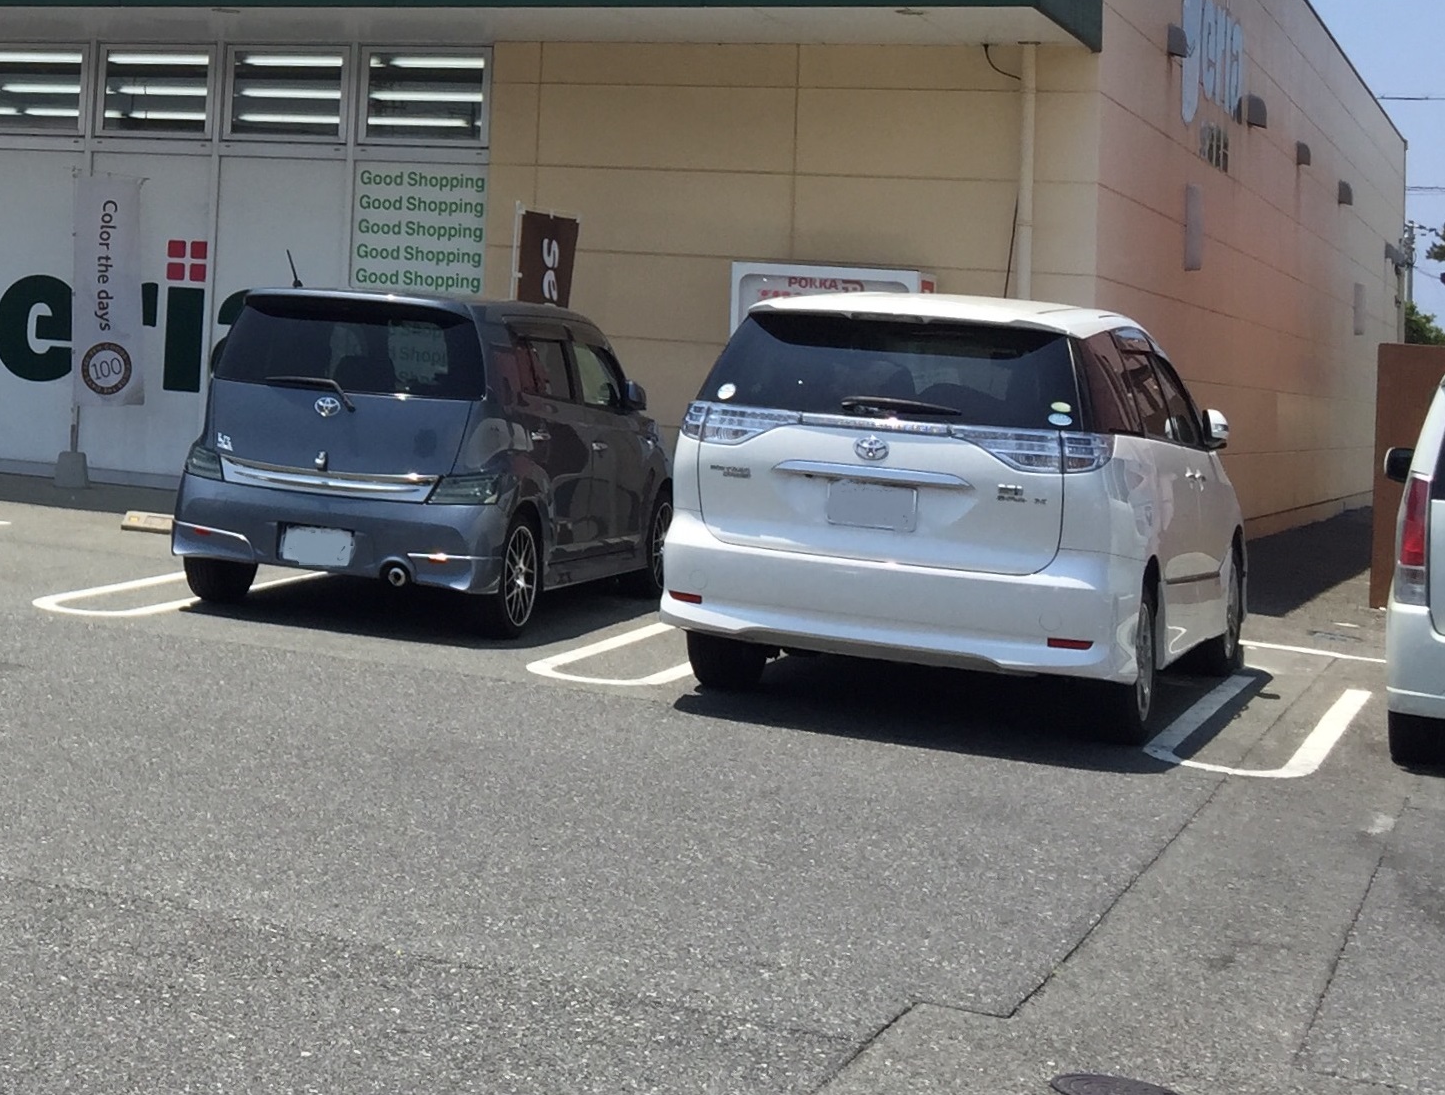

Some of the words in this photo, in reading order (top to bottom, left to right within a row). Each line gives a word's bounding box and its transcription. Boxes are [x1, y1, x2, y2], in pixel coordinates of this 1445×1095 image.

[360, 169, 404, 187] Good
[407, 171, 486, 193] Shopping
[359, 194, 403, 212] Good
[406, 195, 484, 218] Shopping
[98, 199, 118, 251] Color
[358, 218, 402, 236] Good
[405, 220, 483, 243] Shopping
[356, 243, 400, 261] Good
[403, 245, 482, 268] Shopping
[97, 254, 114, 284] the
[355, 267, 399, 285] Good
[402, 269, 481, 293] Shopping
[787, 276, 839, 290] POKKA
[94, 289, 114, 332] days
[90, 357, 122, 380] 100
